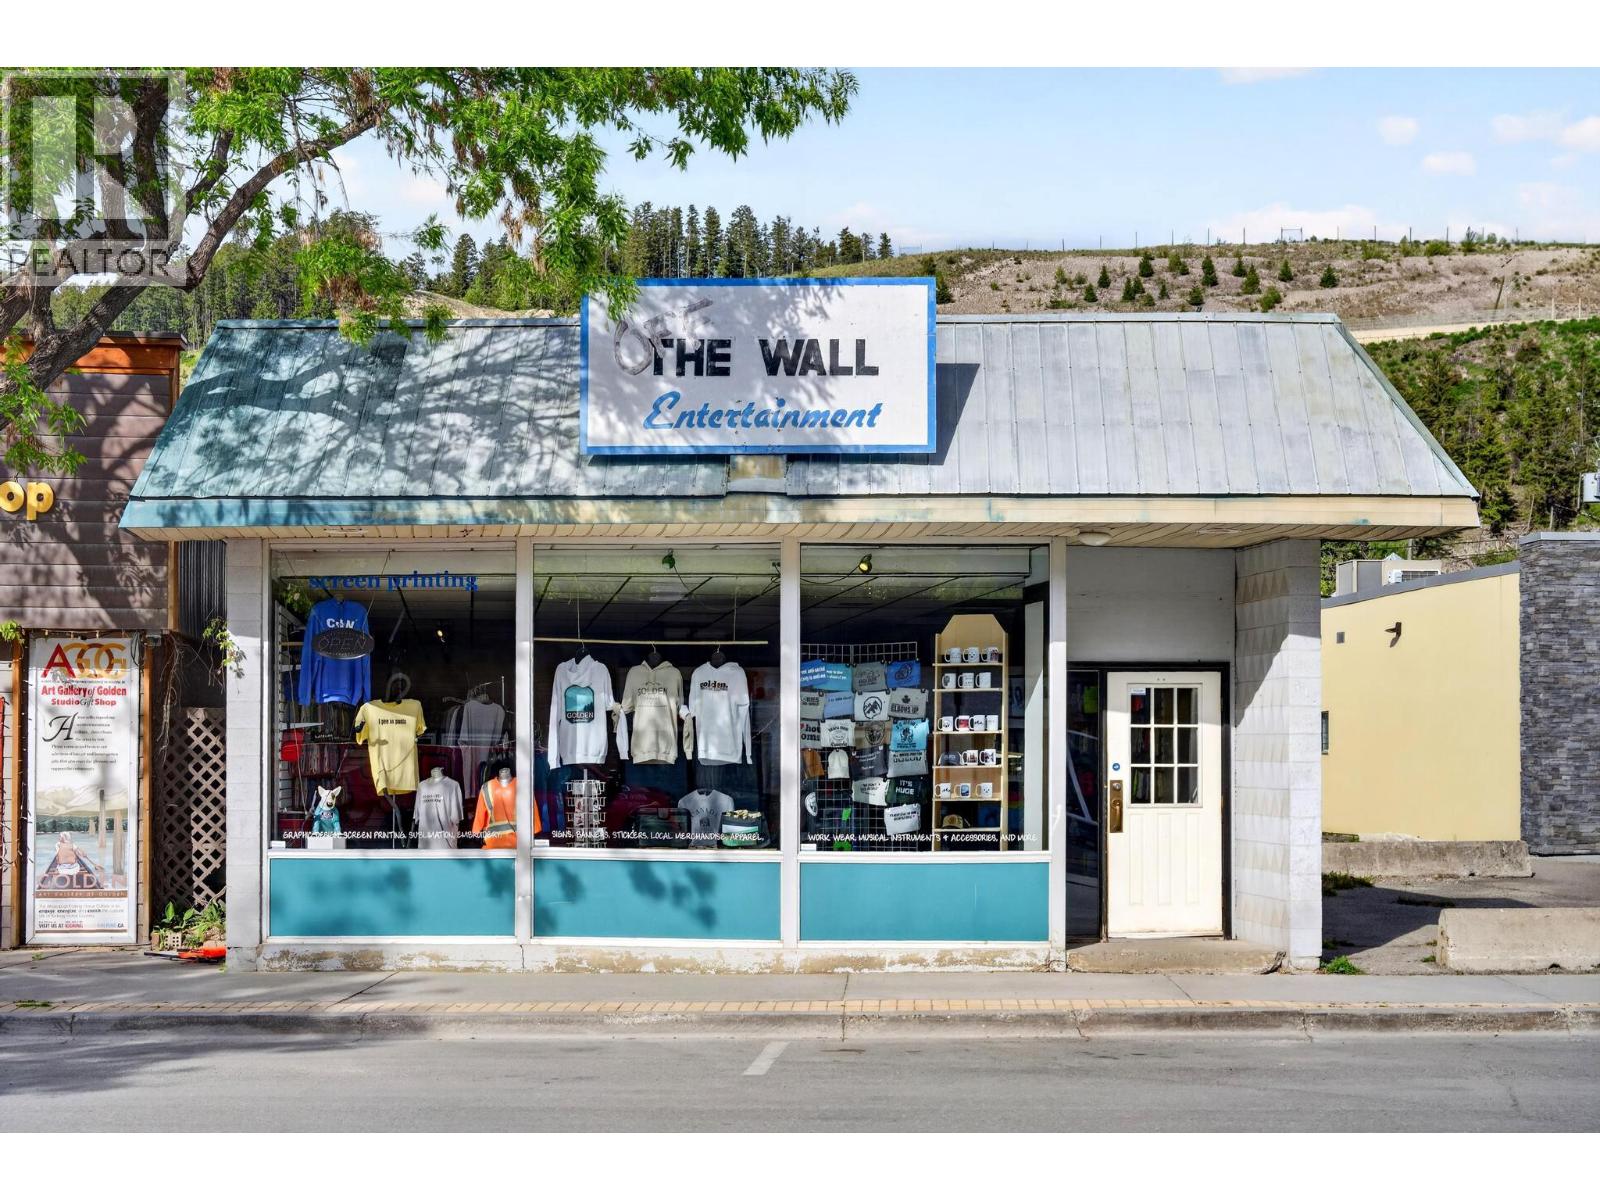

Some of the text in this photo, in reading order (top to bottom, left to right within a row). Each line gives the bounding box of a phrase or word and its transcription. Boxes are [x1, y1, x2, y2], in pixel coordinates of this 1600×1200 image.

[648, 338, 732, 376] THE
[758, 338, 880, 376] WALL
[643, 391, 883, 429] Entertainment
[310, 570, 479, 592] screen printing
[41, 686, 56, 696] Art
[57, 684, 87, 698] Gallery
[97, 685, 127, 696] Golden
[637, 687, 669, 697] GOLDEN
[51, 698, 80, 706] Studio
[94, 698, 117, 708] Shop
[565, 711, 595, 720] GOLDEN
[895, 786, 915, 796] HUGE
[343, 831, 372, 840] SCREEN
[650, 831, 674, 841] LOCAL
[808, 831, 831, 842] WORK
[858, 832, 889, 842] MUSICAL
[890, 832, 941, 842] INSTRUMENTS
[1000, 832, 1016, 842] AND
